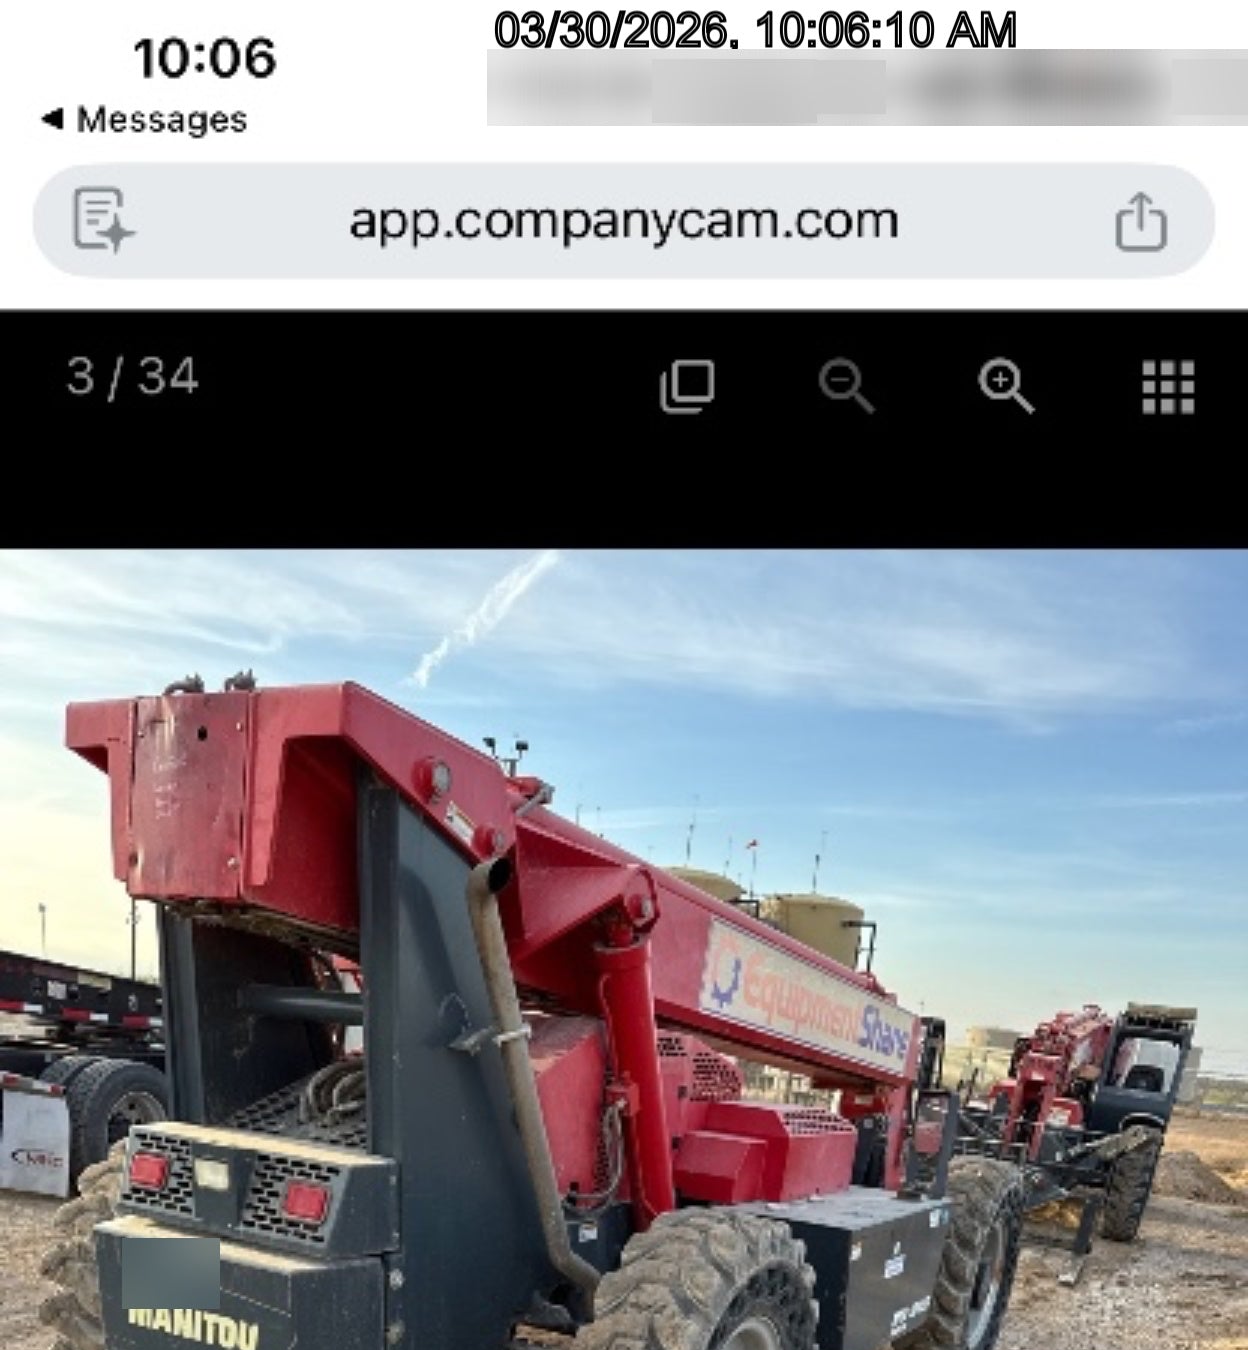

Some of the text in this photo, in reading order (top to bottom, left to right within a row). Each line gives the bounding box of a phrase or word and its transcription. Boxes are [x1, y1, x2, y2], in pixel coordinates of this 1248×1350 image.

[134, 37, 277, 79] 10:06
[78, 105, 247, 139] Messages
[350, 208, 898, 249] app.companycam.com
[67, 356, 199, 402] 3 / 34
